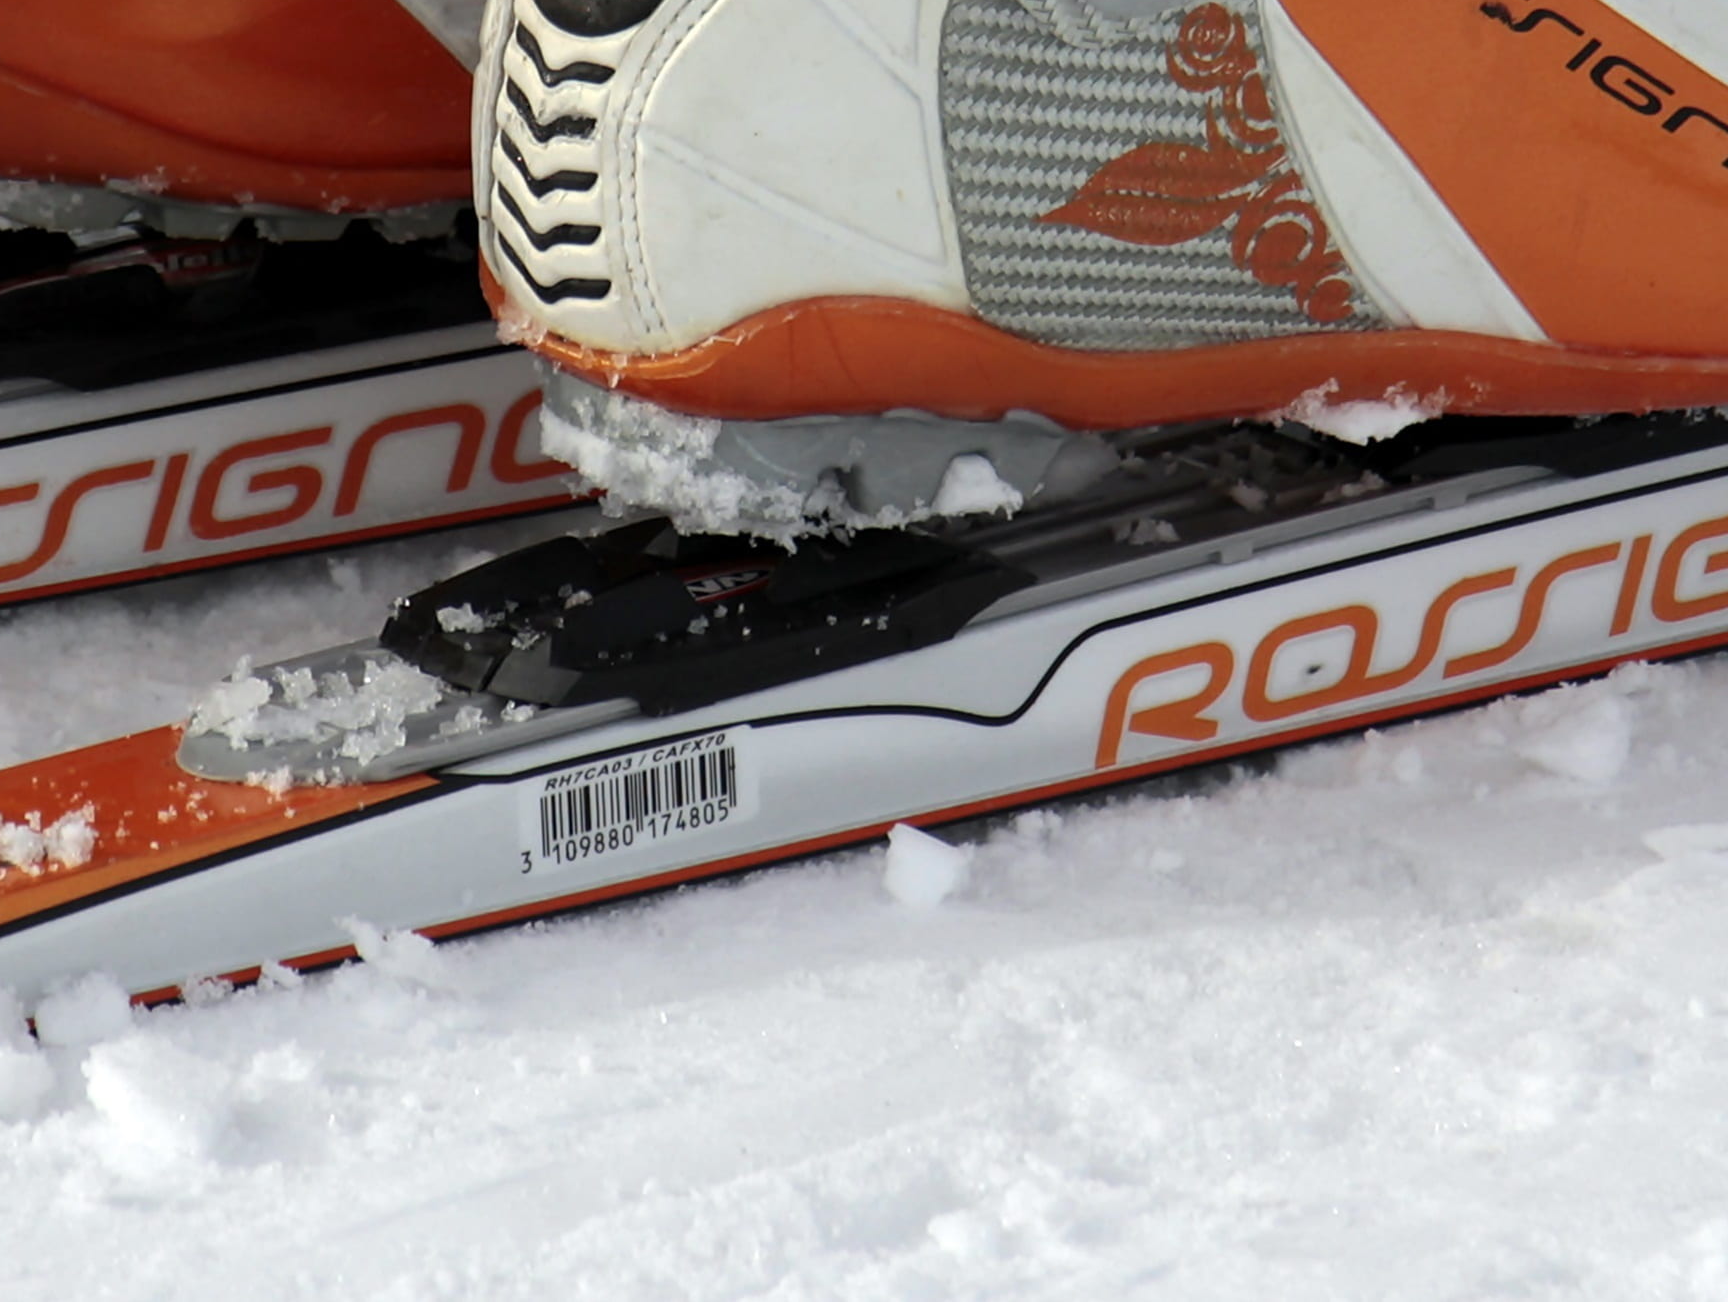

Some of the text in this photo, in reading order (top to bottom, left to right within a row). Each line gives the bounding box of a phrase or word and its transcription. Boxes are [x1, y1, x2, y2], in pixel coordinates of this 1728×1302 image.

[544, 757, 632, 791] RH7CA03
[652, 733, 727, 763] CAFX70
[521, 799, 729, 874] 3 109880 174805
